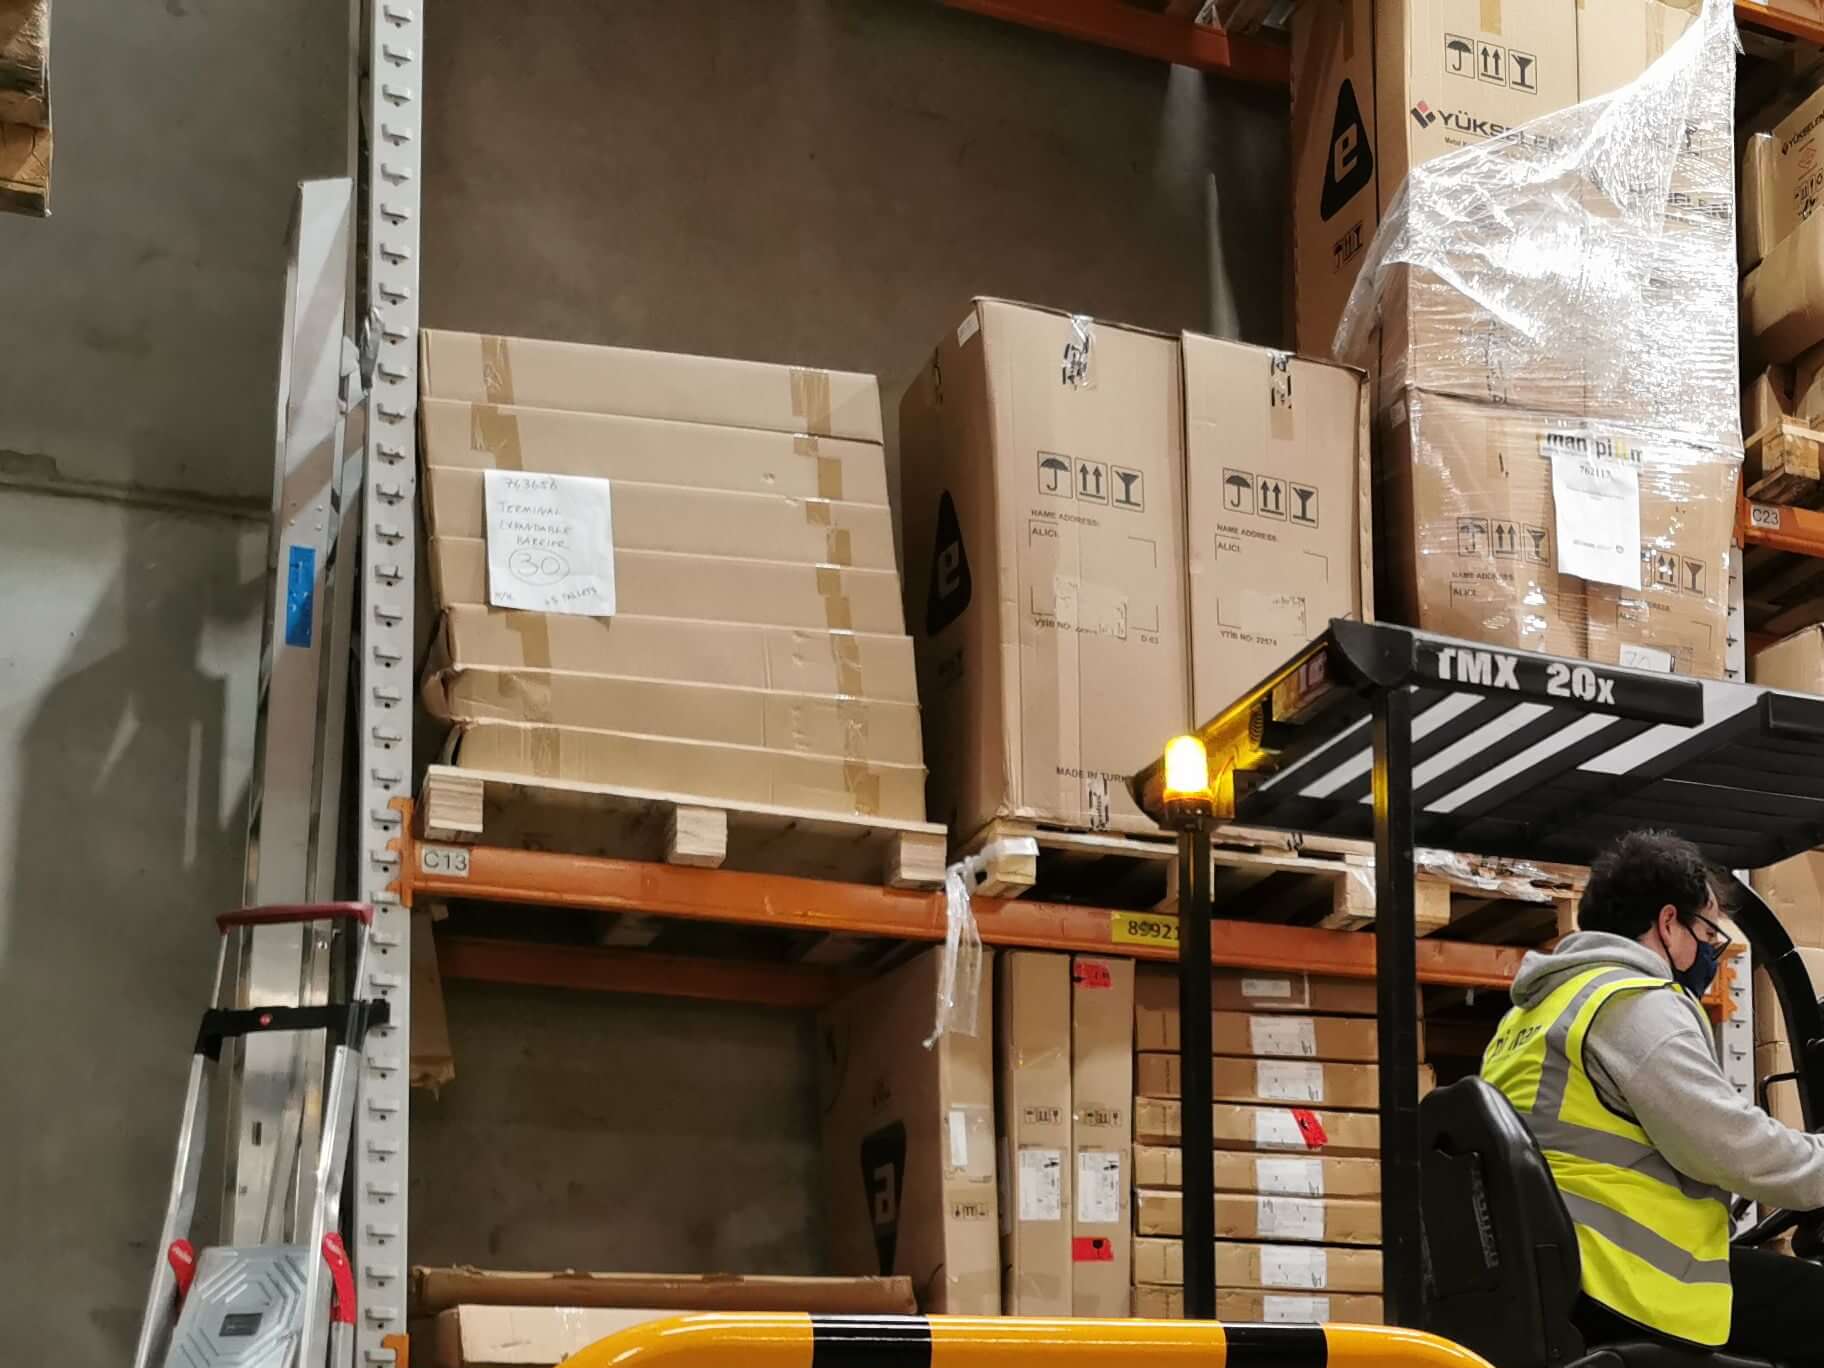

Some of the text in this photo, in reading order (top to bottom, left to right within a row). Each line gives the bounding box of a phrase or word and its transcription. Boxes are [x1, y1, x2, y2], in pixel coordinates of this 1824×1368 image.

[1031, 508, 1057, 519] NAME
[1752, 508, 1779, 525] C23
[1216, 523, 1239, 535] NAME
[518, 552, 561, 577] 30
[1056, 766, 1085, 779] MADE
[1088, 770, 1099, 780] IN
[424, 850, 467, 872] C13
